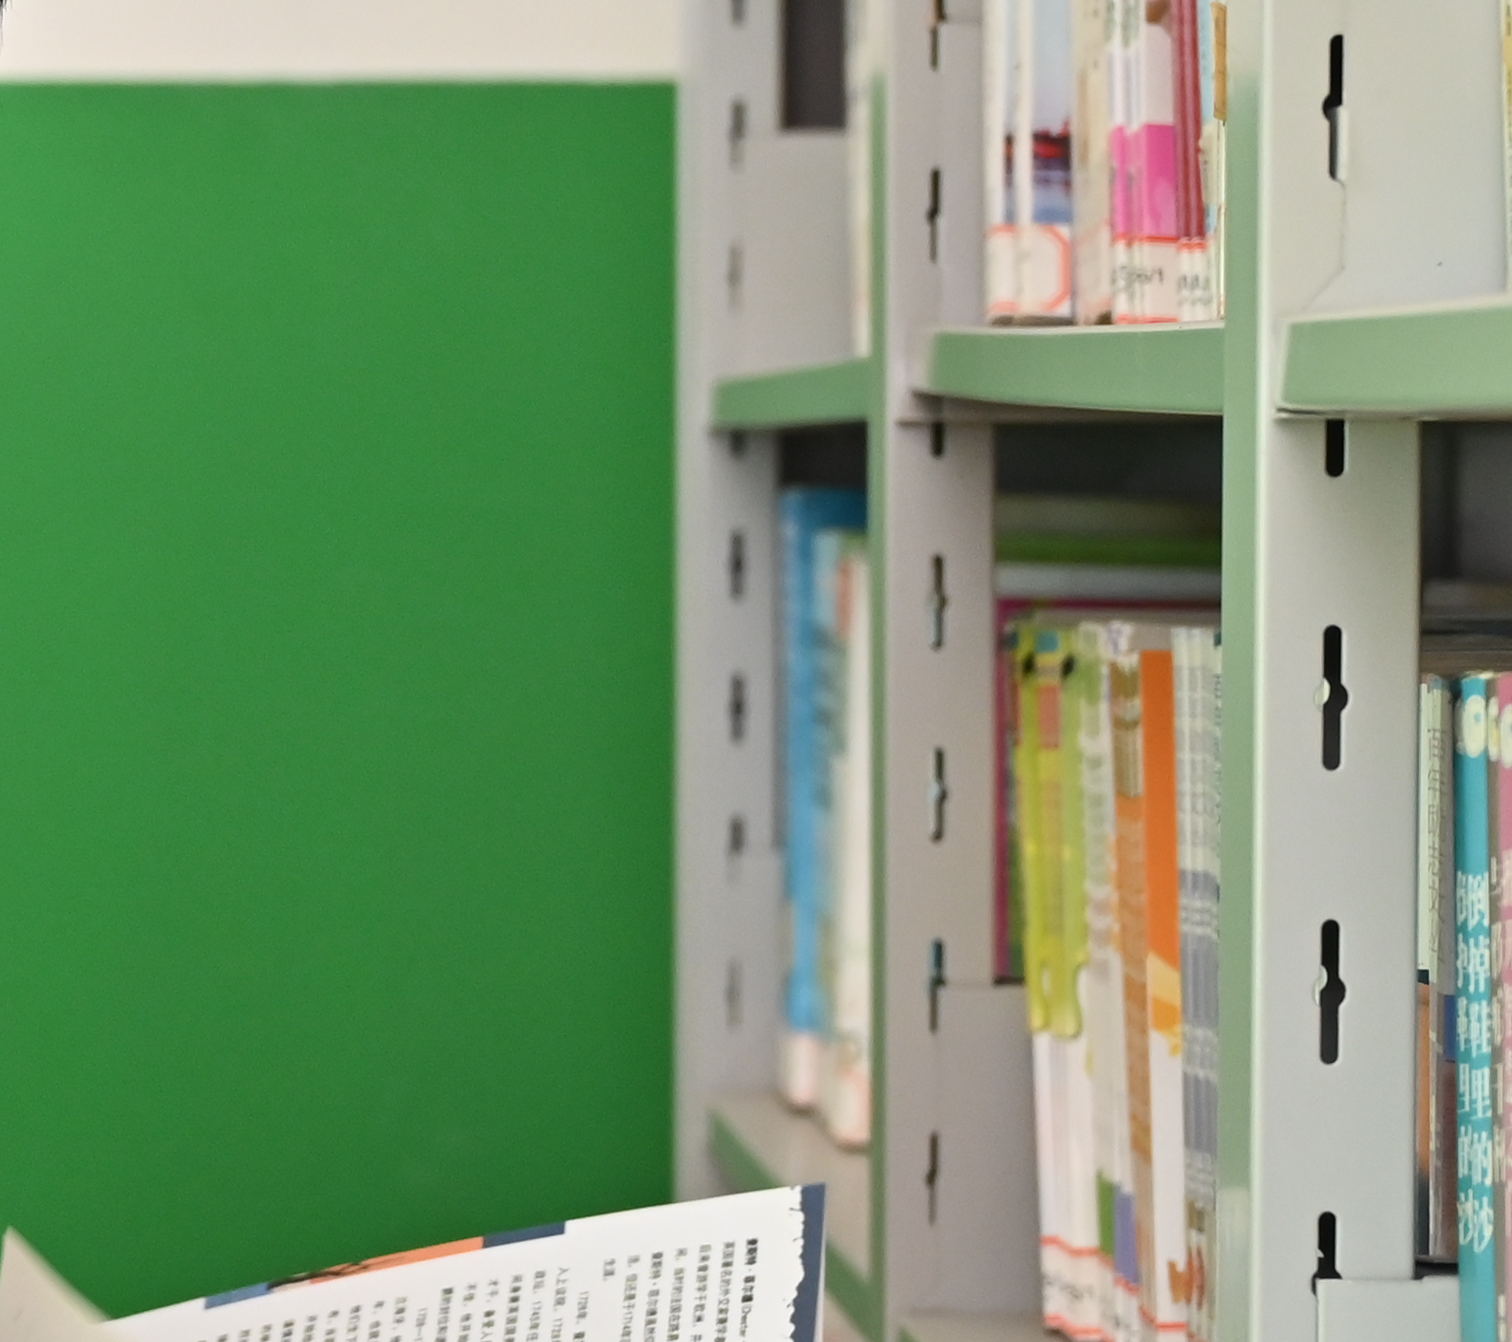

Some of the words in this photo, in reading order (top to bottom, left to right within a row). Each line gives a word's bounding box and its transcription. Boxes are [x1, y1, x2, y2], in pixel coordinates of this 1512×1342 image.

[1467, 872, 1494, 1253] 倒掉鞋里的沙
